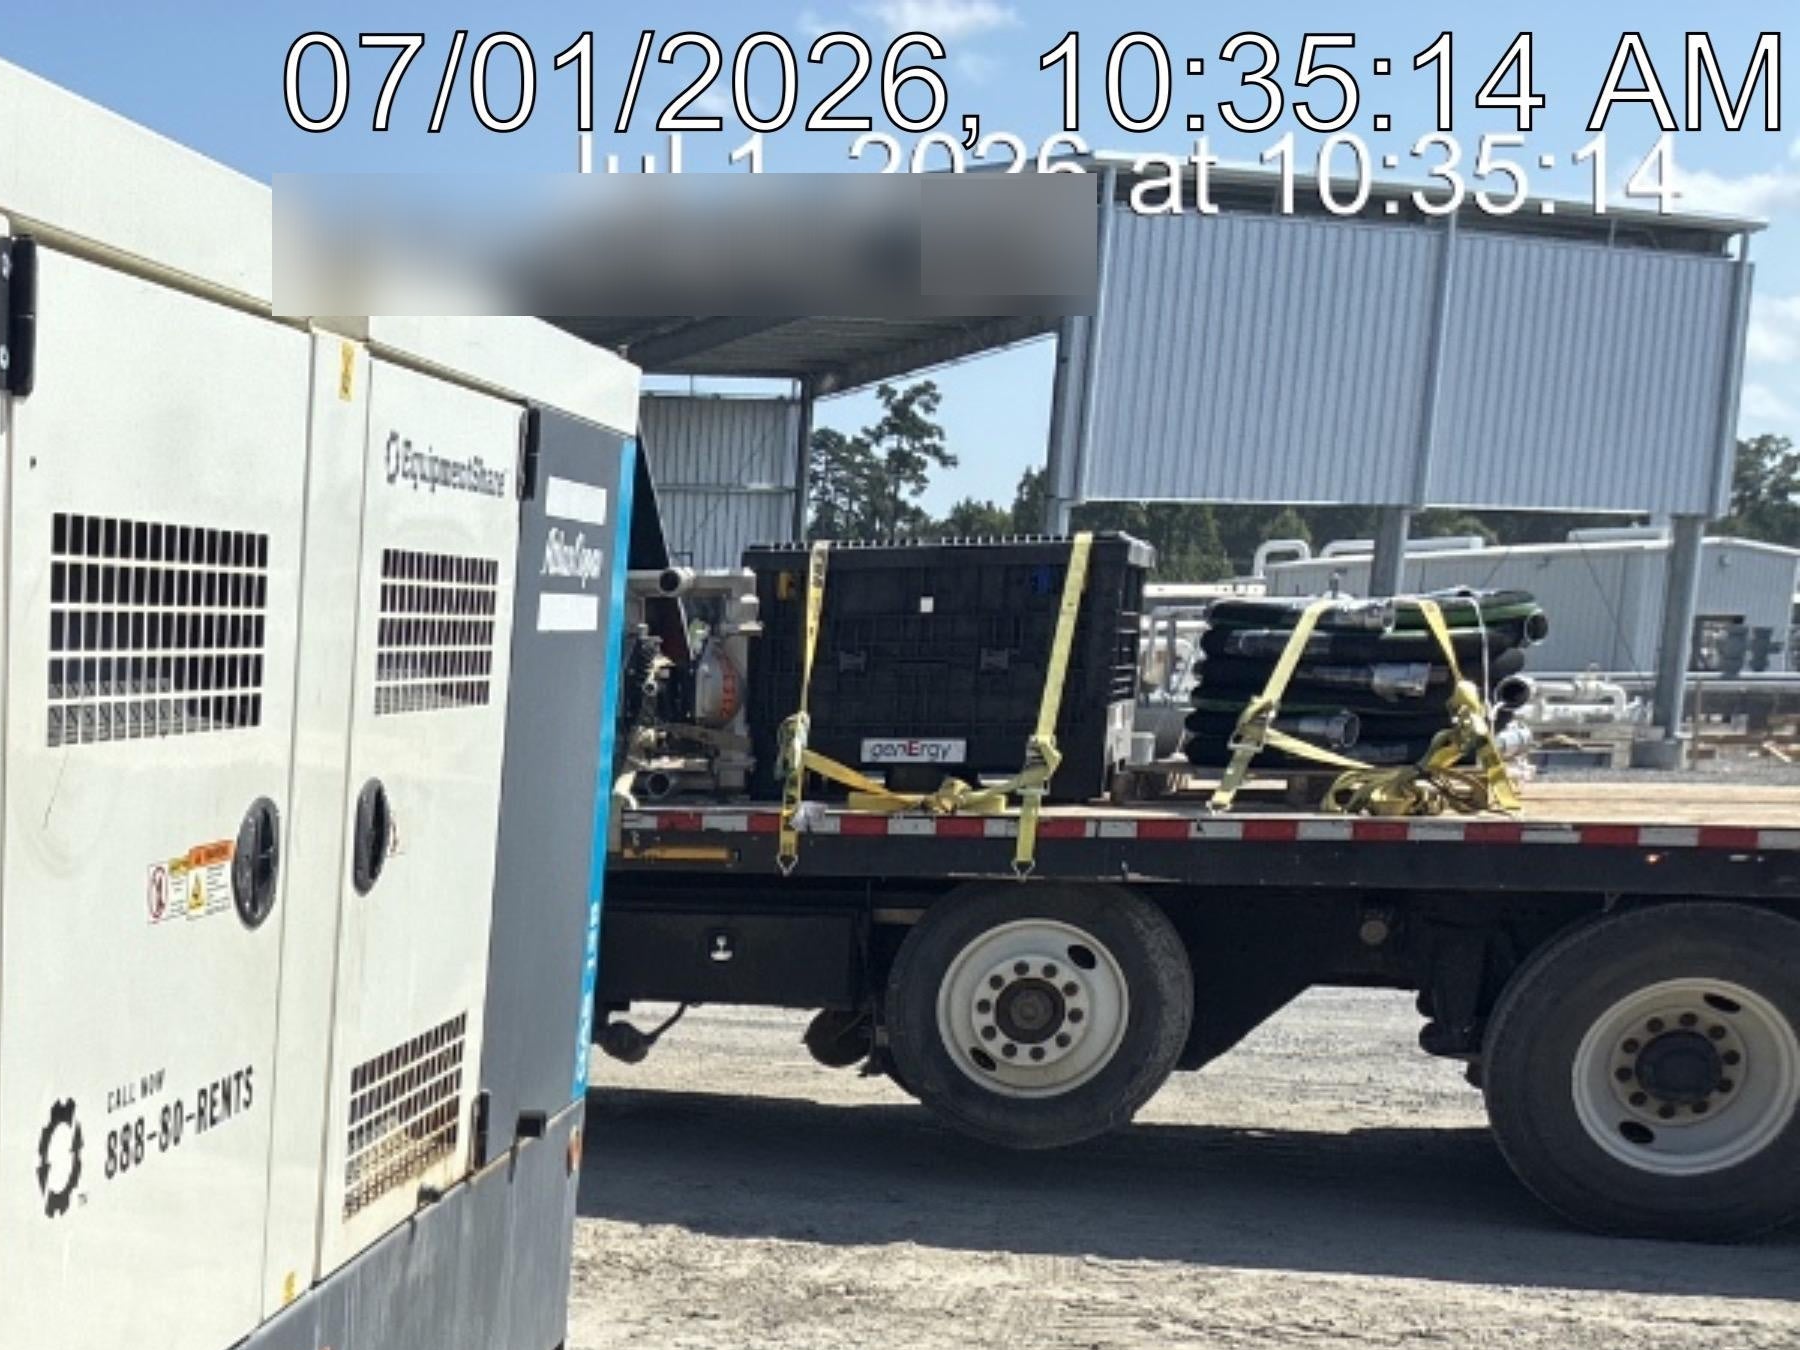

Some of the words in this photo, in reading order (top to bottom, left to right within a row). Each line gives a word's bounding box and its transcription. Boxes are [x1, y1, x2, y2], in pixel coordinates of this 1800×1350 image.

[871, 740, 953, 762] genErgy
[106, 1082, 136, 1114] CALL
[140, 1067, 166, 1098] NOW
[104, 1064, 254, 1180] 888-80-RENTS
